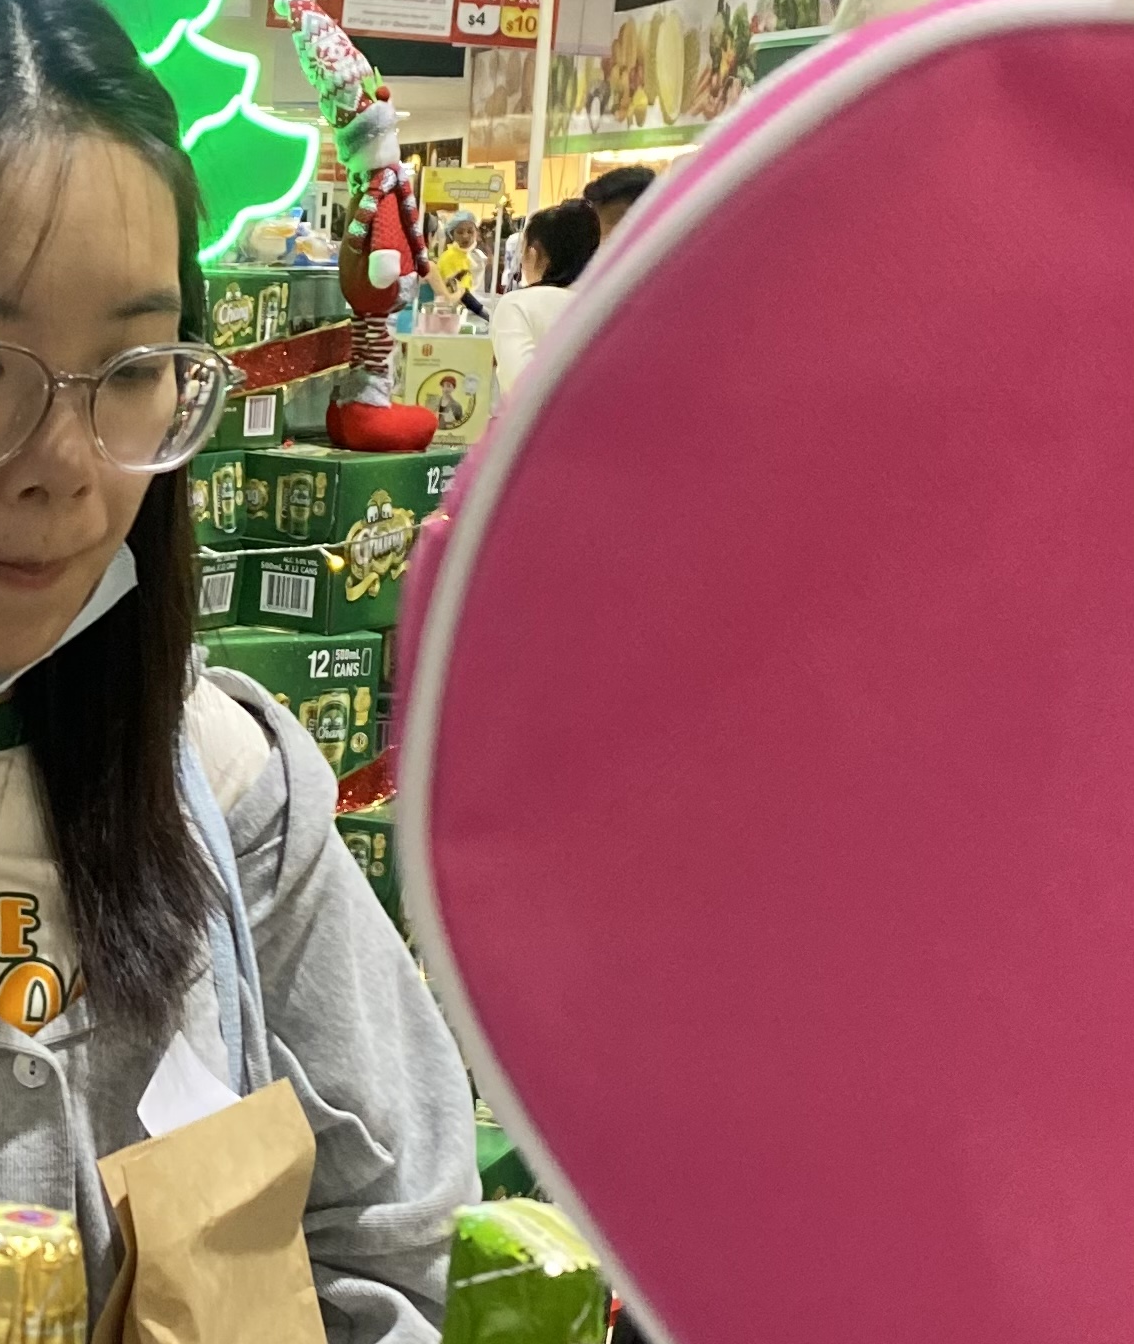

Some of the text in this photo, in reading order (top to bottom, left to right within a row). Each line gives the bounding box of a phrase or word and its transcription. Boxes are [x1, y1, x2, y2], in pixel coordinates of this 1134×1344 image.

[468, 12, 485, 26] $4
[507, 15, 537, 32] $10
[427, 466, 440, 494] 12
[308, 650, 330, 678] 12
[334, 663, 359, 677] CANS
